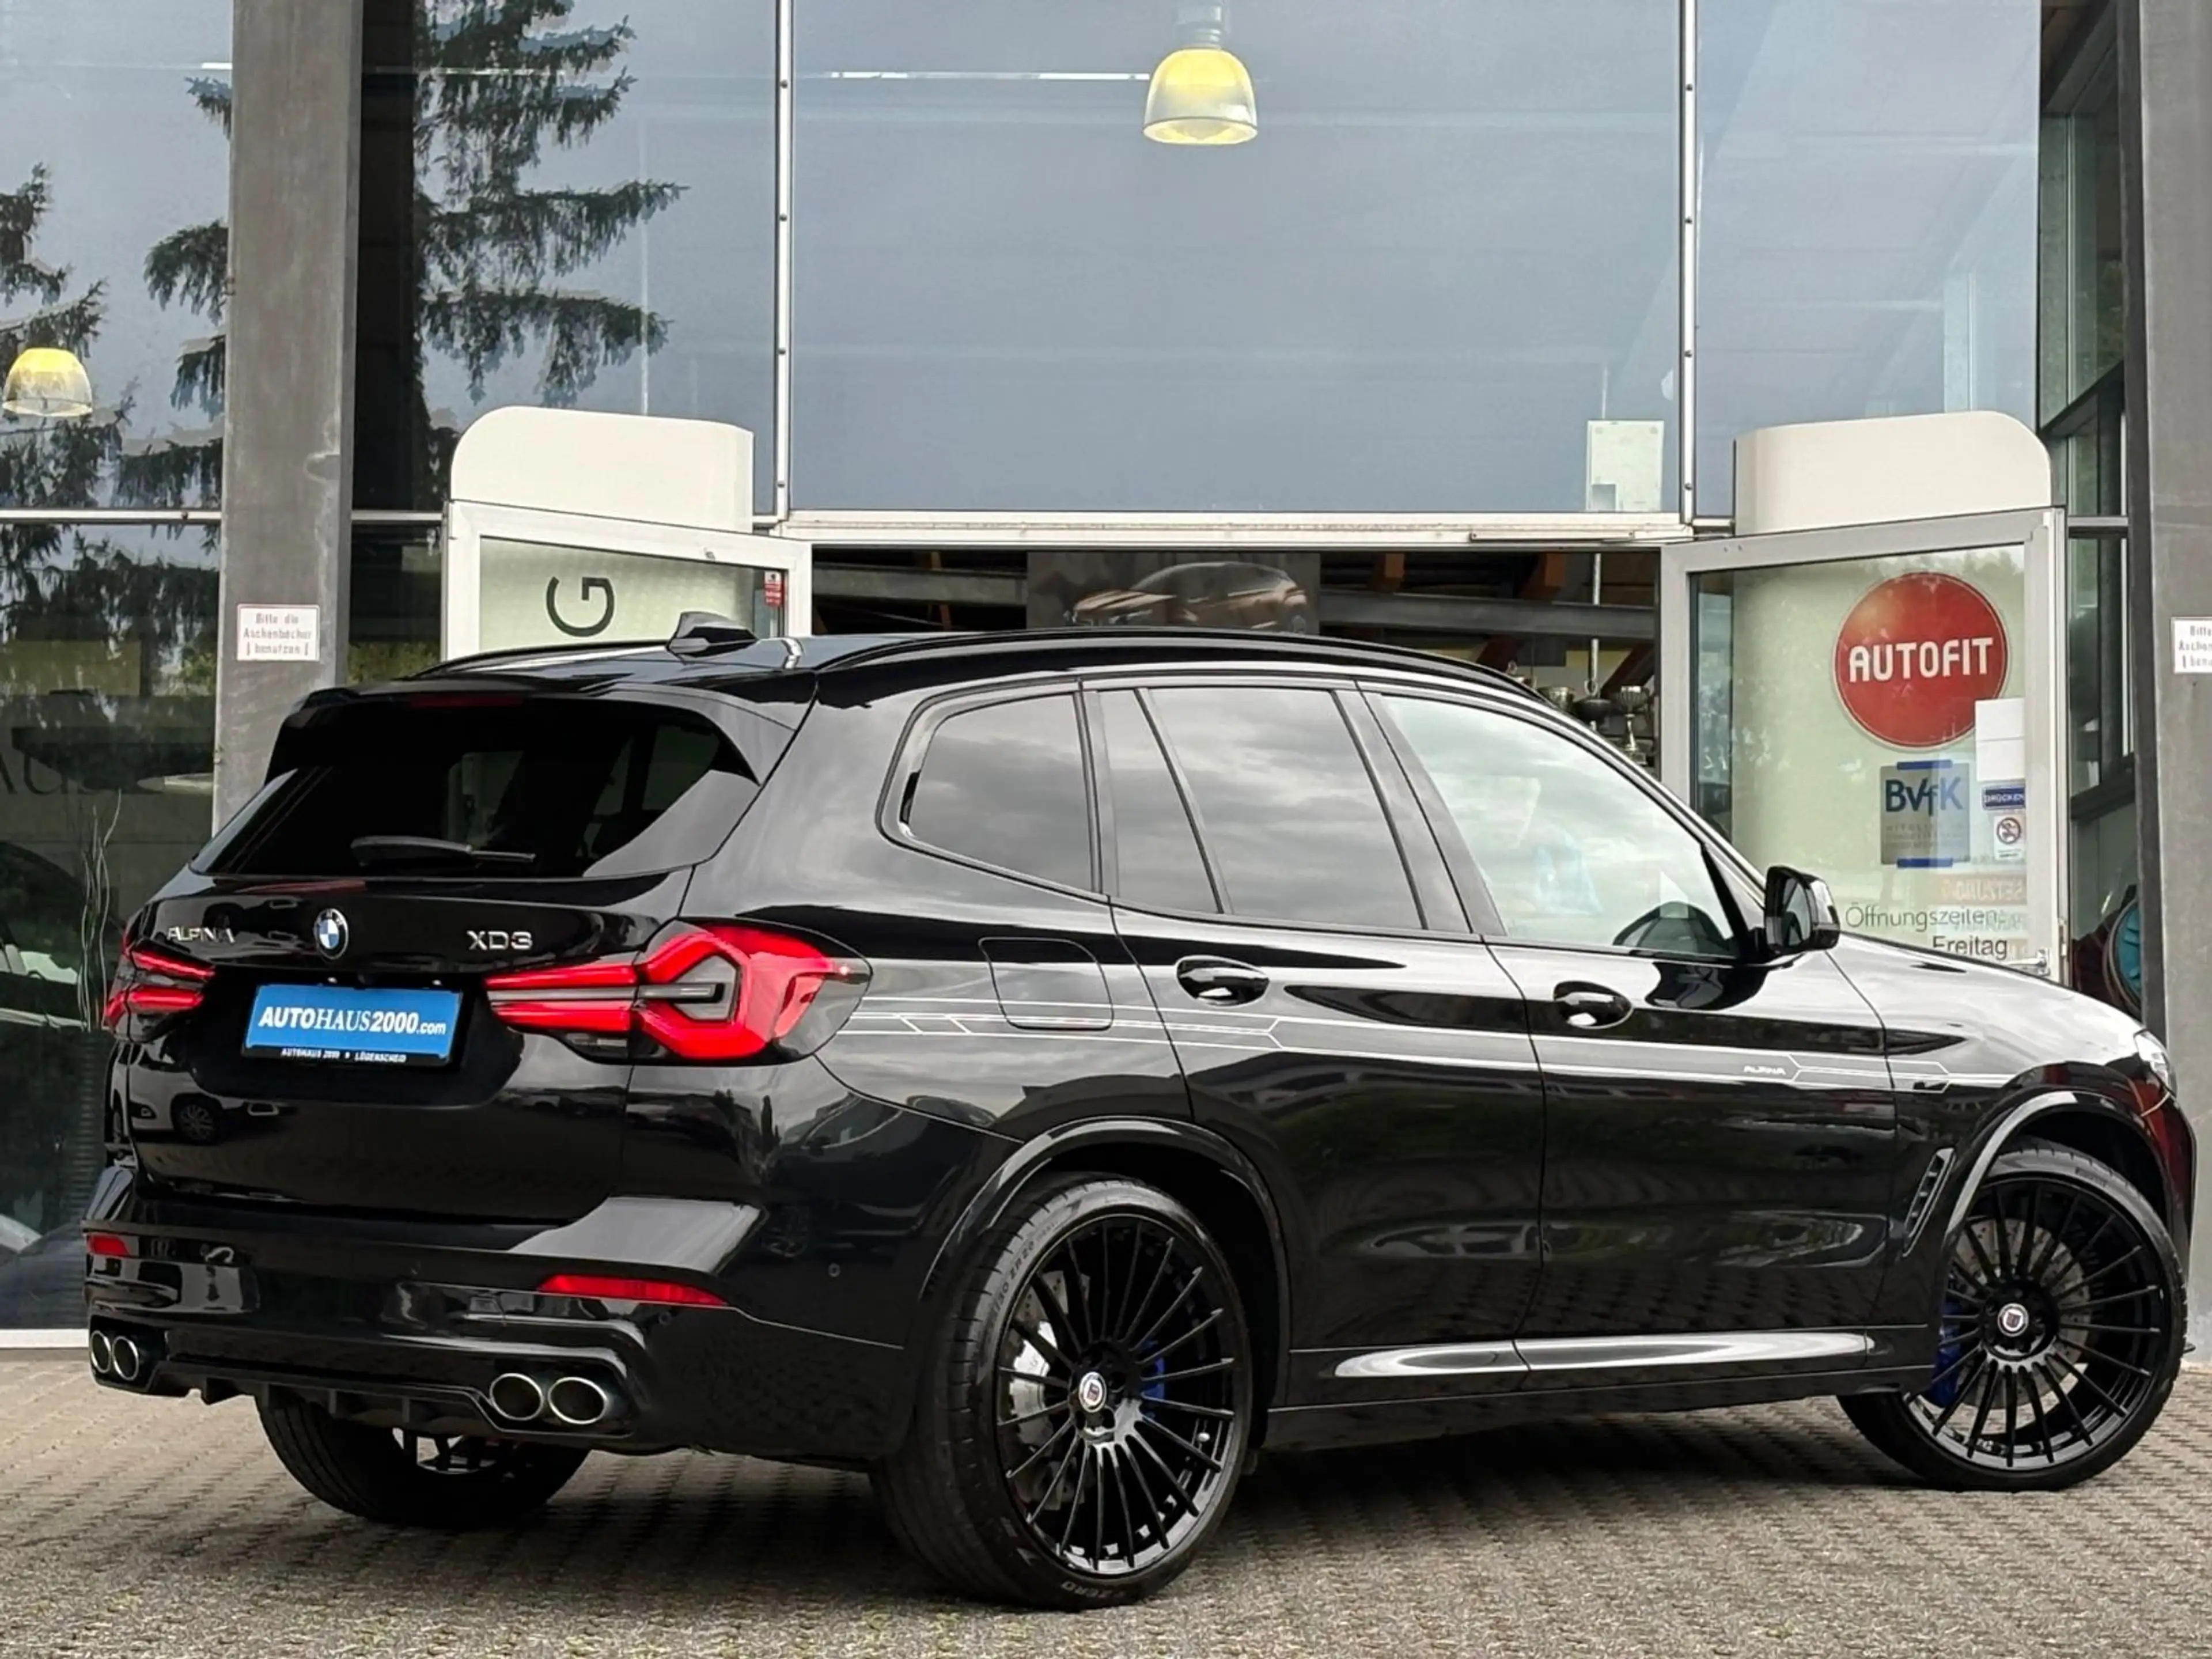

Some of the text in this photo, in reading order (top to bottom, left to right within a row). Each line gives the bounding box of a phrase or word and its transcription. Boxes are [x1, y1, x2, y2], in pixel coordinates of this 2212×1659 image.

[1849, 637, 1994, 683] AUTOFIT
[166, 926, 235, 944] ALPINA
[467, 930, 533, 950] XD3
[1933, 934, 2008, 960] Freitag
[258, 1006, 446, 1036] AUTOHAUS2000.com
